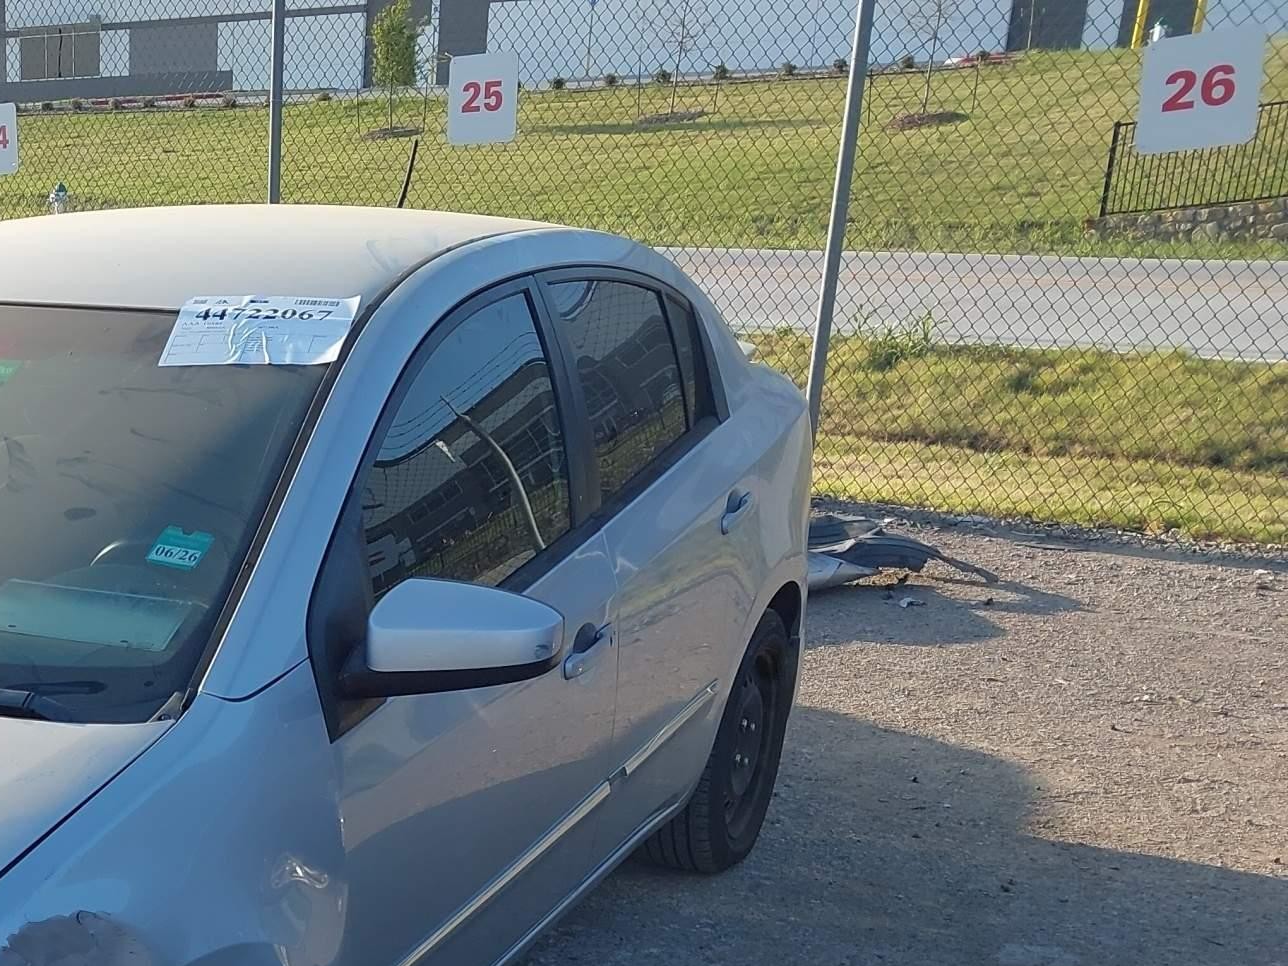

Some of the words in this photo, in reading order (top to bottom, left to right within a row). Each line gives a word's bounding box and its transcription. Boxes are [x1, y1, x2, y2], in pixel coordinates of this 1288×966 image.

[461, 80, 503, 113] 25
[1161, 64, 1236, 113] 26
[195, 307, 334, 321] 44722067
[155, 546, 198, 562] 06/26
